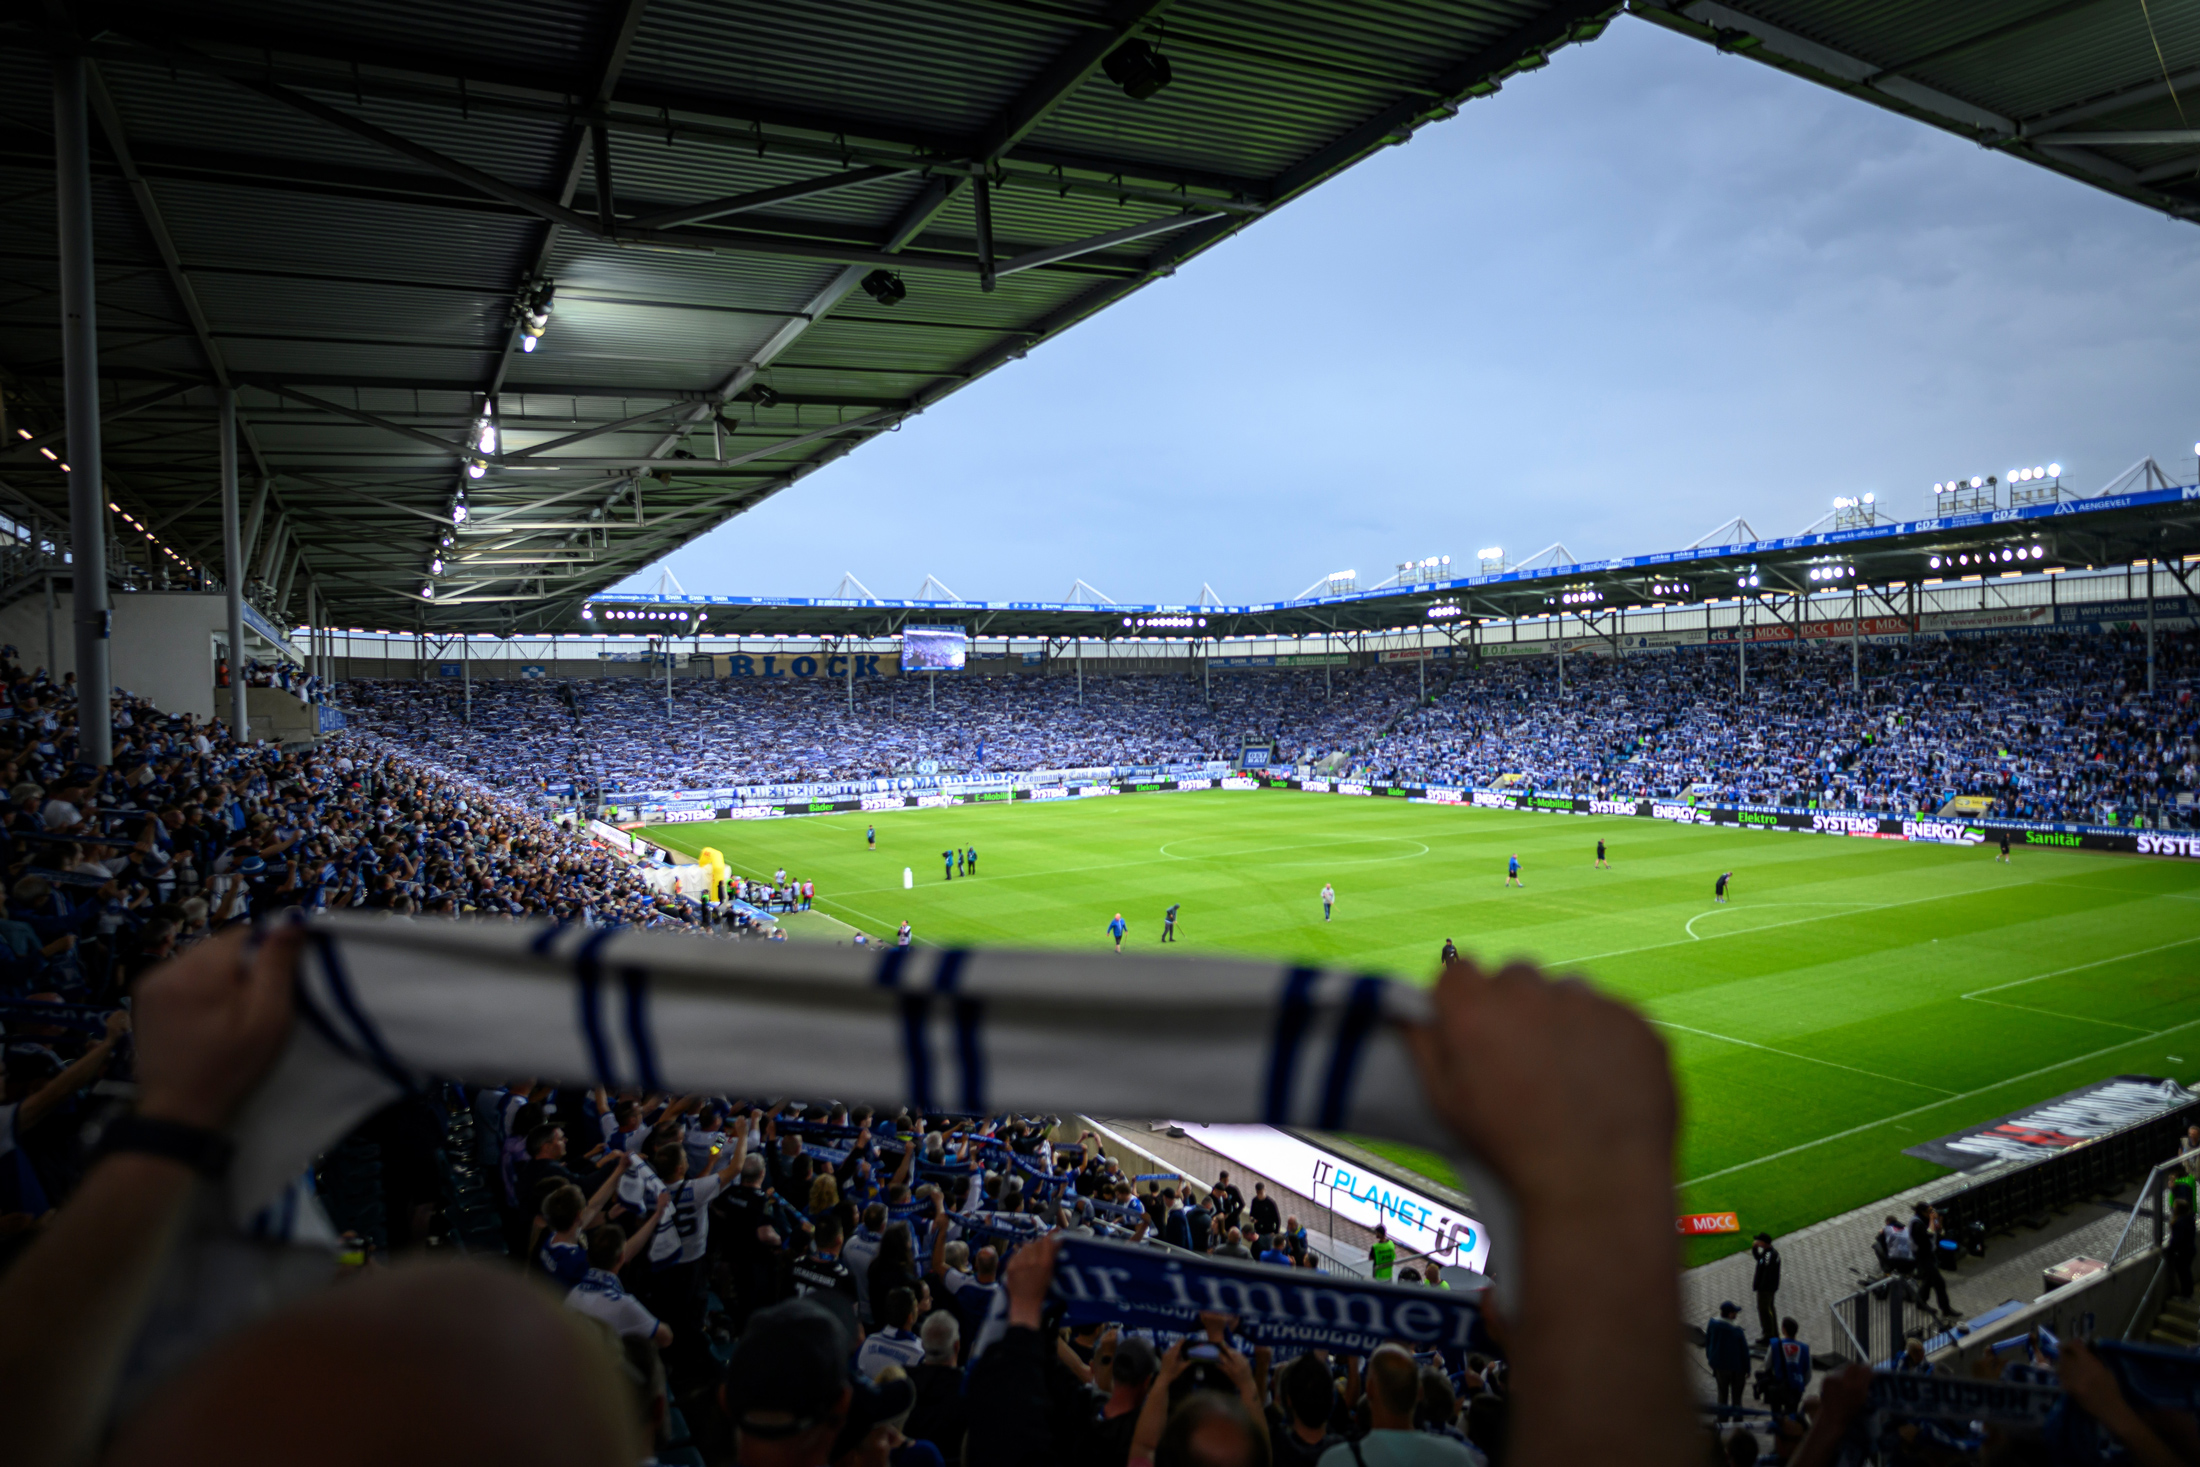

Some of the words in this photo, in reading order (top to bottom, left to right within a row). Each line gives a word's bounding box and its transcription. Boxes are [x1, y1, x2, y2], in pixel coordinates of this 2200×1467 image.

[2078, 497, 2131, 512] AENGEVELT
[1992, 508, 2018, 521] CDZ
[1915, 519, 1940, 531] CDZ
[1831, 527, 1889, 541] www.kk-office.com
[1468, 575, 1488, 586] FEGERT
[2080, 606, 2102, 616] WIR
[2155, 601, 2179, 611] DAS
[1833, 620, 1870, 632] MDC
[1875, 618, 1909, 630] MDC
[1951, 614, 2028, 626] www.wg1893.de
[1756, 626, 1789, 638] MDCC
[1876, 633, 1941, 645] OSTTRBÜNE
[1482, 644, 1543, 656] B.O.D.-Hochbau
[728, 654, 881, 678] BLOCK
[887, 778, 908, 791] FC
[1136, 783, 1160, 792] Elektro
[1177, 778, 1212, 790] SYSTEMS
[1221, 777, 1254, 789] ENERGY
[1270, 779, 1288, 788] Sanitär
[1301, 781, 1331, 793] SYSTEMS
[1337, 783, 1364, 794] ENERGY
[1029, 786, 1069, 799] SYSTEMS
[1079, 785, 1111, 797] ENERGY
[1386, 788, 1407, 797] Bäder
[1425, 789, 1464, 802] SYSTEMS
[861, 797, 907, 810] SYSTEMS
[917, 795, 954, 807] ENERGY
[1472, 792, 1507, 805] ENERGY
[1527, 796, 1574, 810] E-Mobilität
[731, 806, 773, 819] ENERGY
[808, 803, 835, 812] Bäder
[1589, 800, 1637, 816] SYSTEMS
[1652, 804, 1697, 820] ENERGY
[665, 809, 717, 823] SYSTEMS
[1738, 811, 1778, 825] Elektro
[1812, 815, 1879, 834] SYSTEMS
[1902, 821, 1965, 840] ENERGY
[2025, 831, 2083, 848] Sanitär
[2136, 835, 2200, 858] SYSTE
[1313, 1159, 1333, 1184] IT
[1333, 1168, 1432, 1233] PLANET
[1693, 1215, 1736, 1231] MDCC
